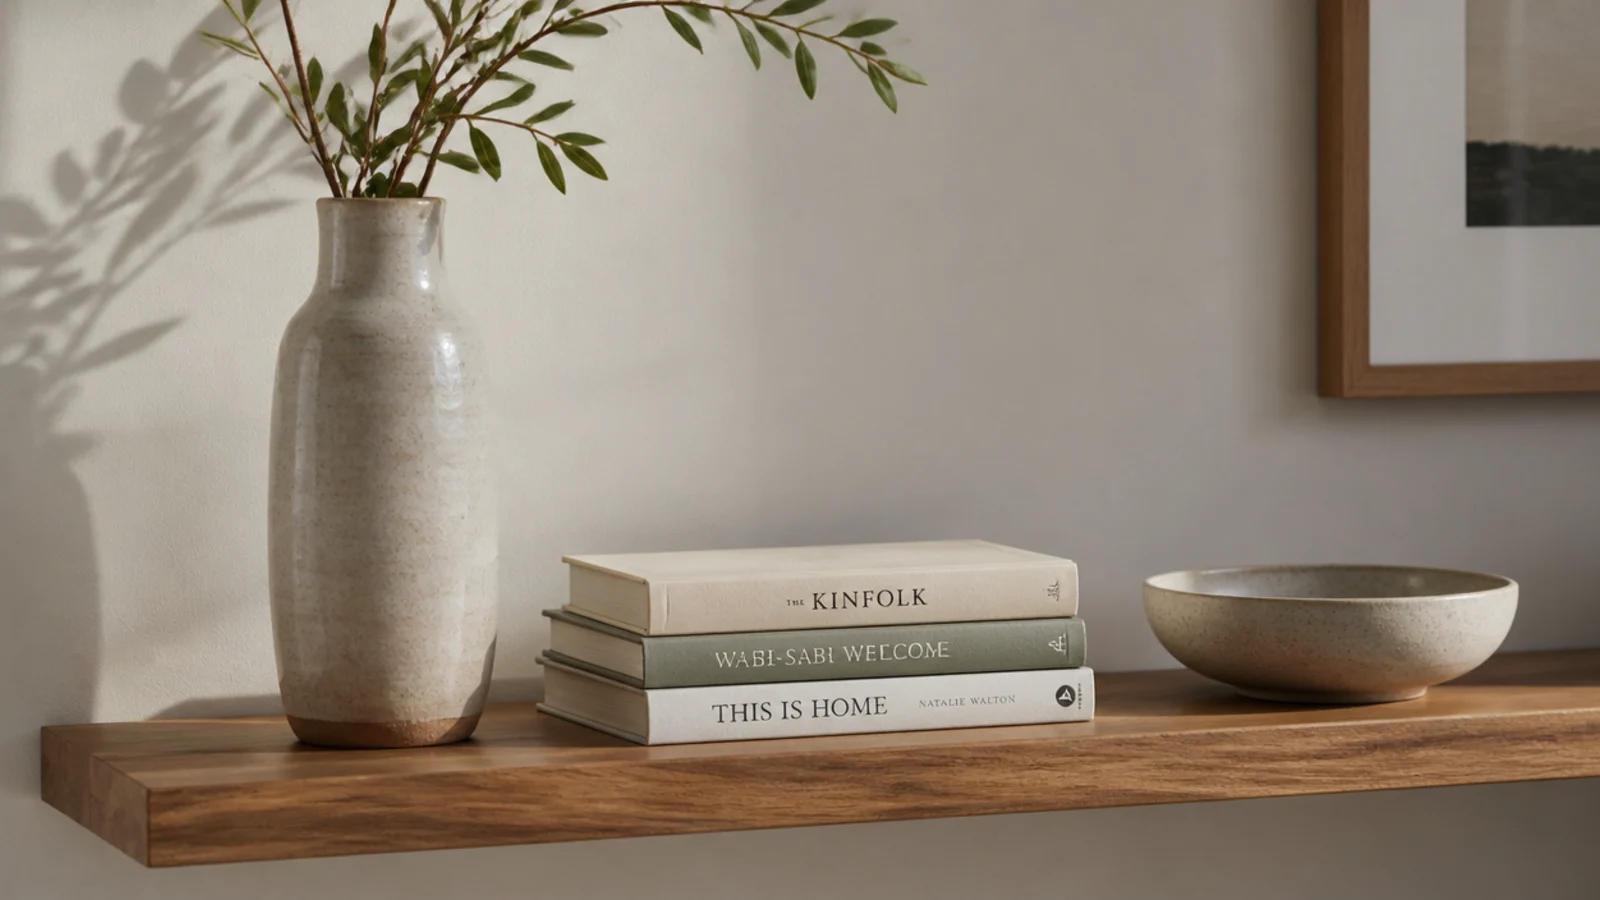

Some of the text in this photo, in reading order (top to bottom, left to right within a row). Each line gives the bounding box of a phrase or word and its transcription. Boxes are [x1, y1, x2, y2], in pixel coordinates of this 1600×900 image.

[812, 588, 928, 611] KINFOLK
[715, 641, 950, 669] WABI-SABI WELCOME
[712, 696, 888, 724] THIS IS HOME
[918, 694, 1016, 708] NATALIE WALTON
